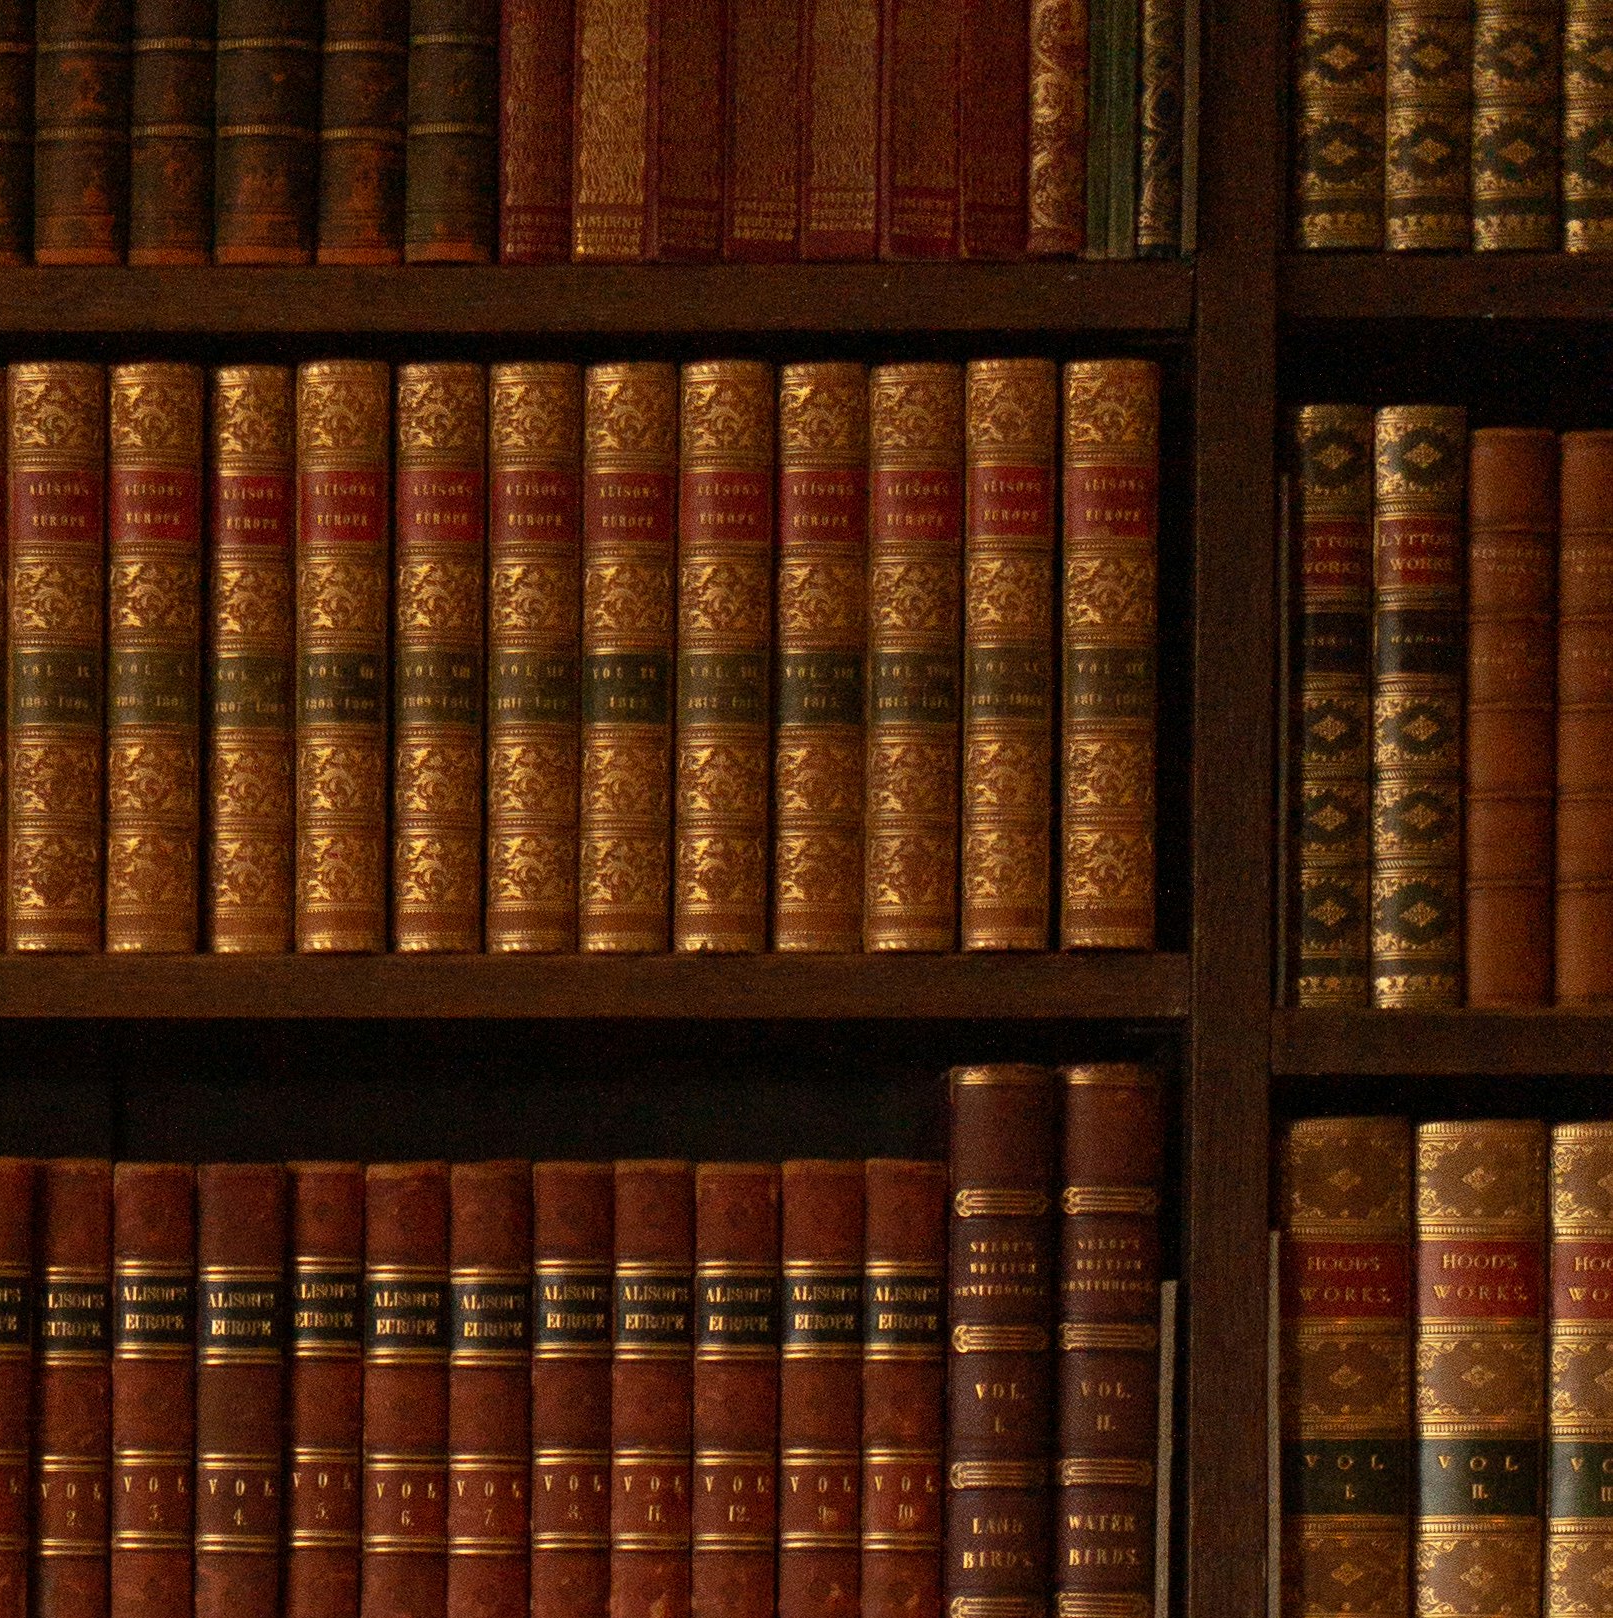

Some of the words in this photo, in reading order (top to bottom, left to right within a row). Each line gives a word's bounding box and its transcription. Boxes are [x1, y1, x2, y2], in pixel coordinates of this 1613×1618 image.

[125, 1314, 185, 1330] EUROPE
[211, 1319, 272, 1336] EUROPE
[294, 1312, 354, 1327] EUROPE
[375, 1319, 437, 1335] EUROPE
[546, 1314, 605, 1329] EUROPE
[625, 1314, 684, 1331] EUROPE
[708, 1316, 769, 1332] EUROPE
[794, 1314, 854, 1330] EUROPE
[878, 1314, 937, 1331] EUROPE
[42, 1321, 101, 1337] EUROPE
[463, 1321, 523, 1338] EUROPE
[972, 1518, 1022, 1535] LAND
[1068, 1514, 1136, 1532] WATER
